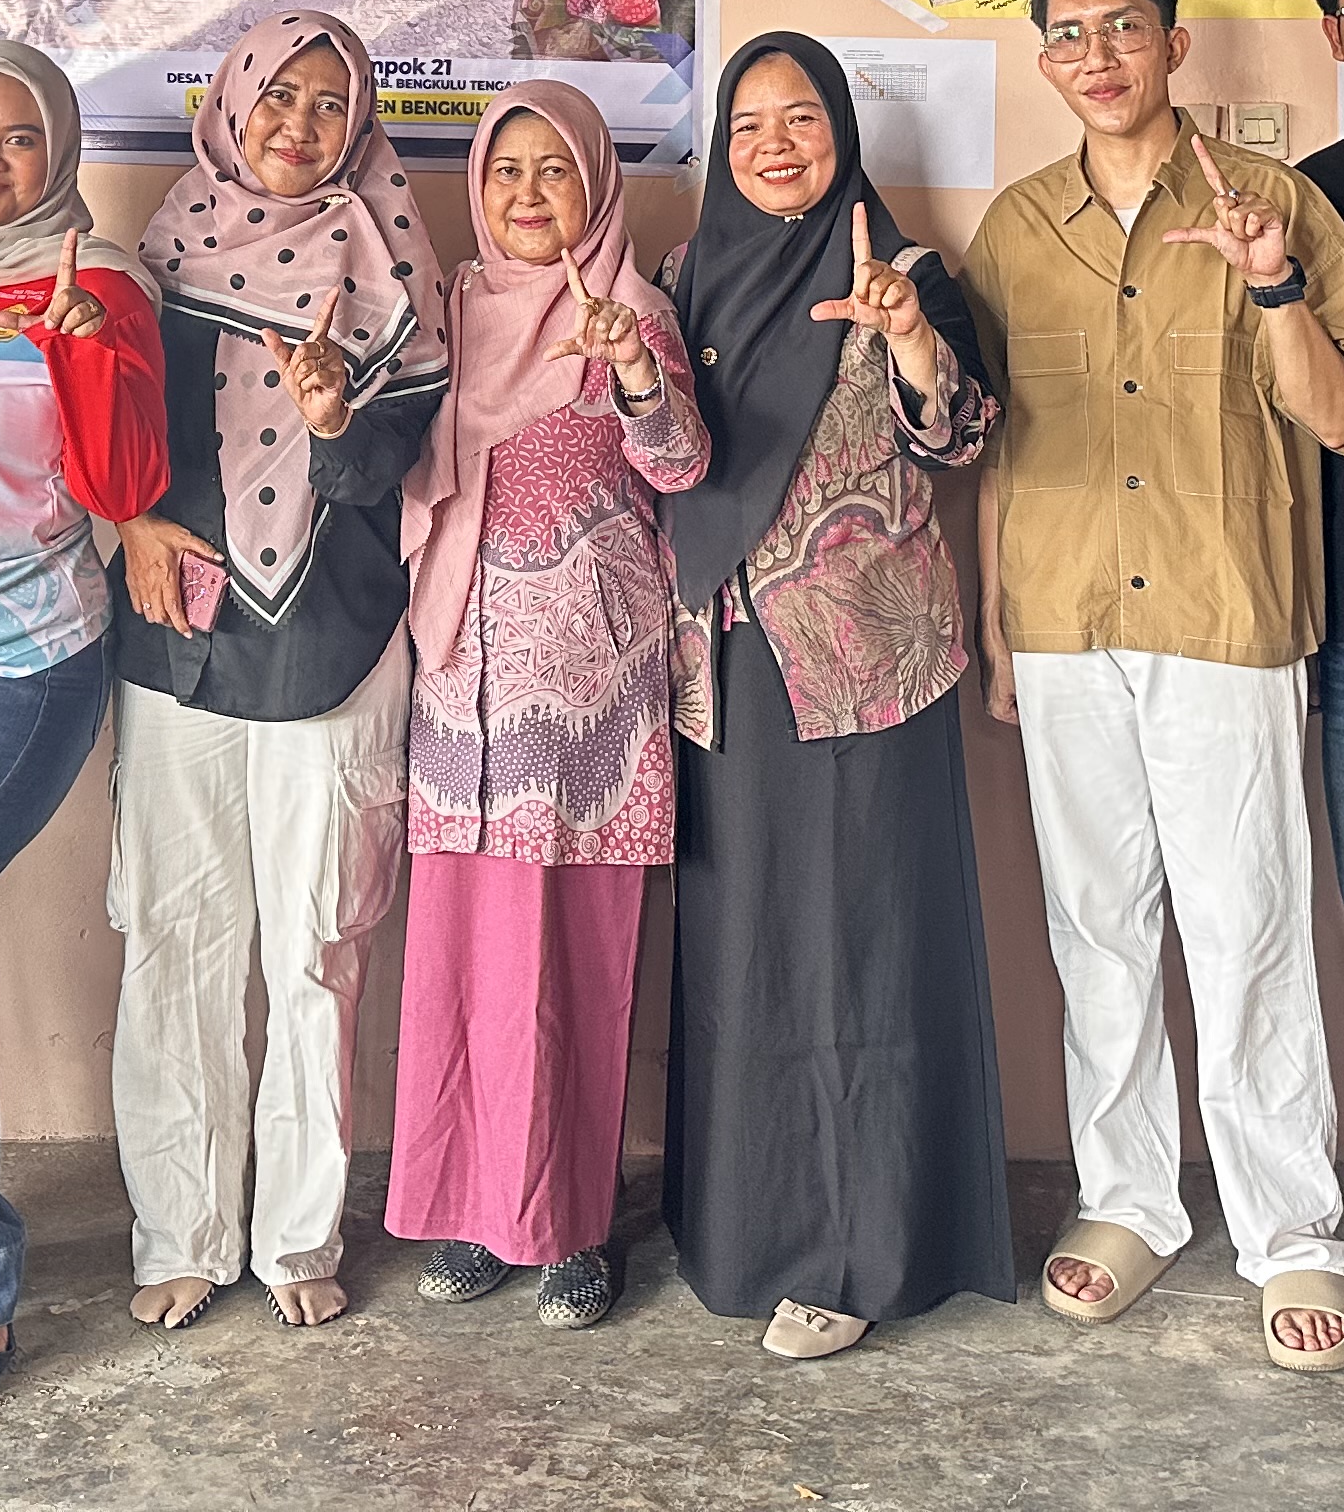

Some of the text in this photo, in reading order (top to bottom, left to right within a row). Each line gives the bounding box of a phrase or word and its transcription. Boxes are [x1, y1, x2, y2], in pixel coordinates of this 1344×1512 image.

[372, 58, 452, 78] mpok 21
[167, 73, 203, 84] DESA
[396, 78, 466, 91] BENGKULU
[469, 80, 517, 92] TENGA
[401, 100, 490, 117] BENGKUL
